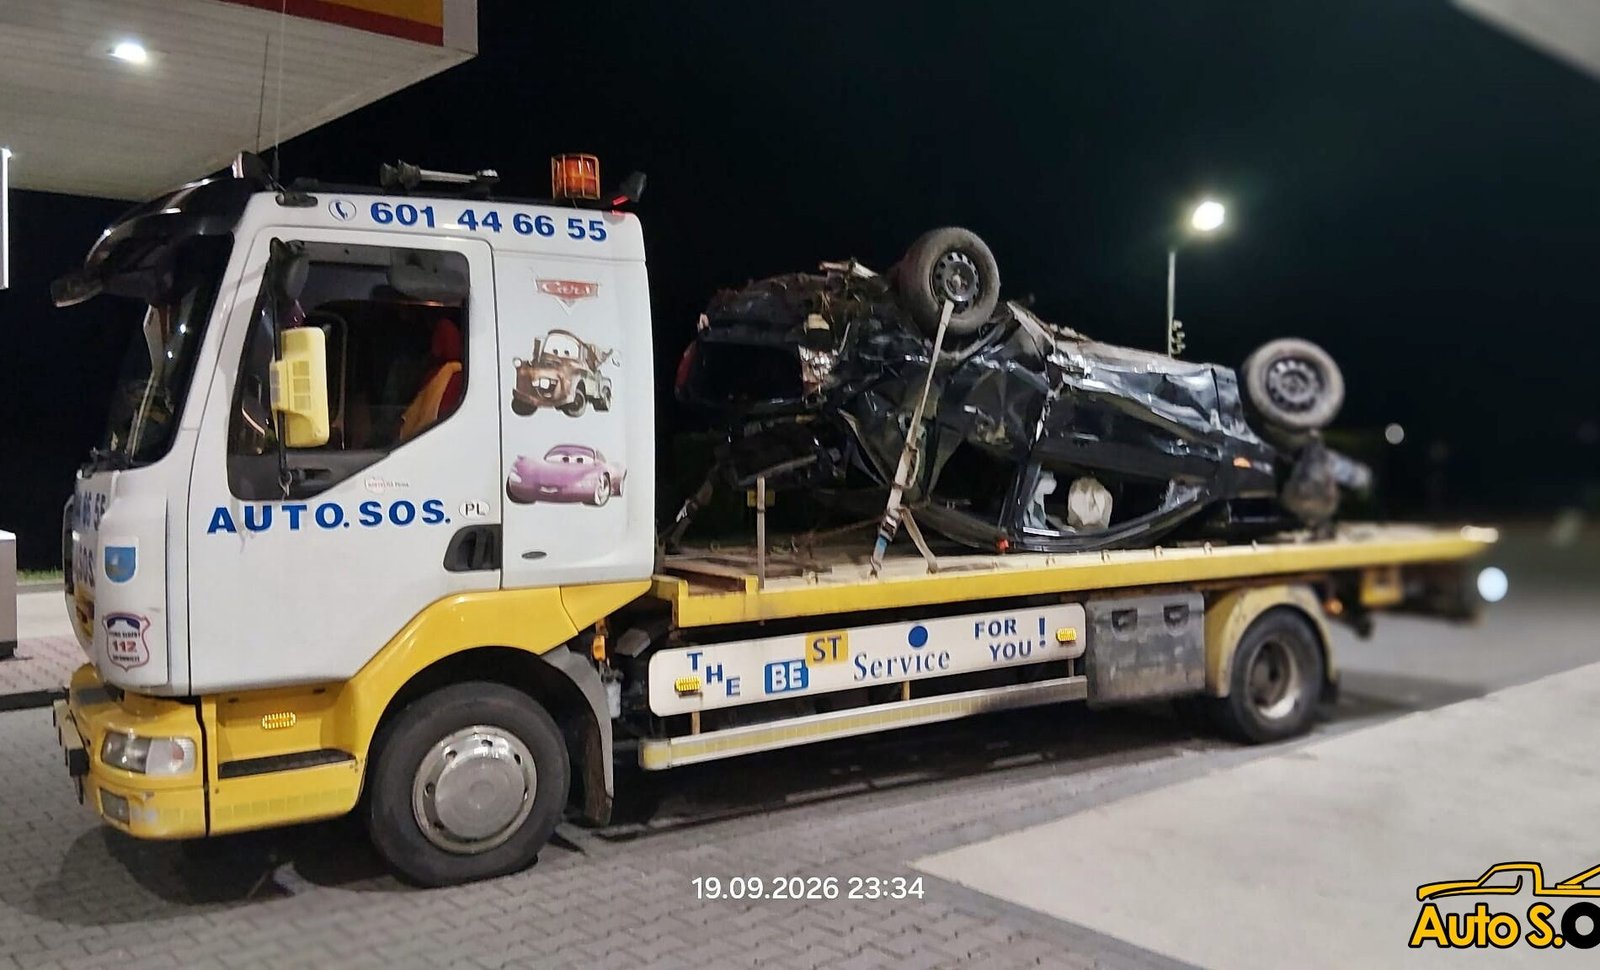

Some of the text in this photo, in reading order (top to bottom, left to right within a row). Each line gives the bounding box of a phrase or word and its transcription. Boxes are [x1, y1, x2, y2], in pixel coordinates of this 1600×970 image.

[370, 202, 607, 242] 601 44 66 55
[465, 503, 486, 516] PL
[973, 618, 1017, 640] FOR
[113, 641, 137, 652] 112
[853, 650, 951, 682] Service
